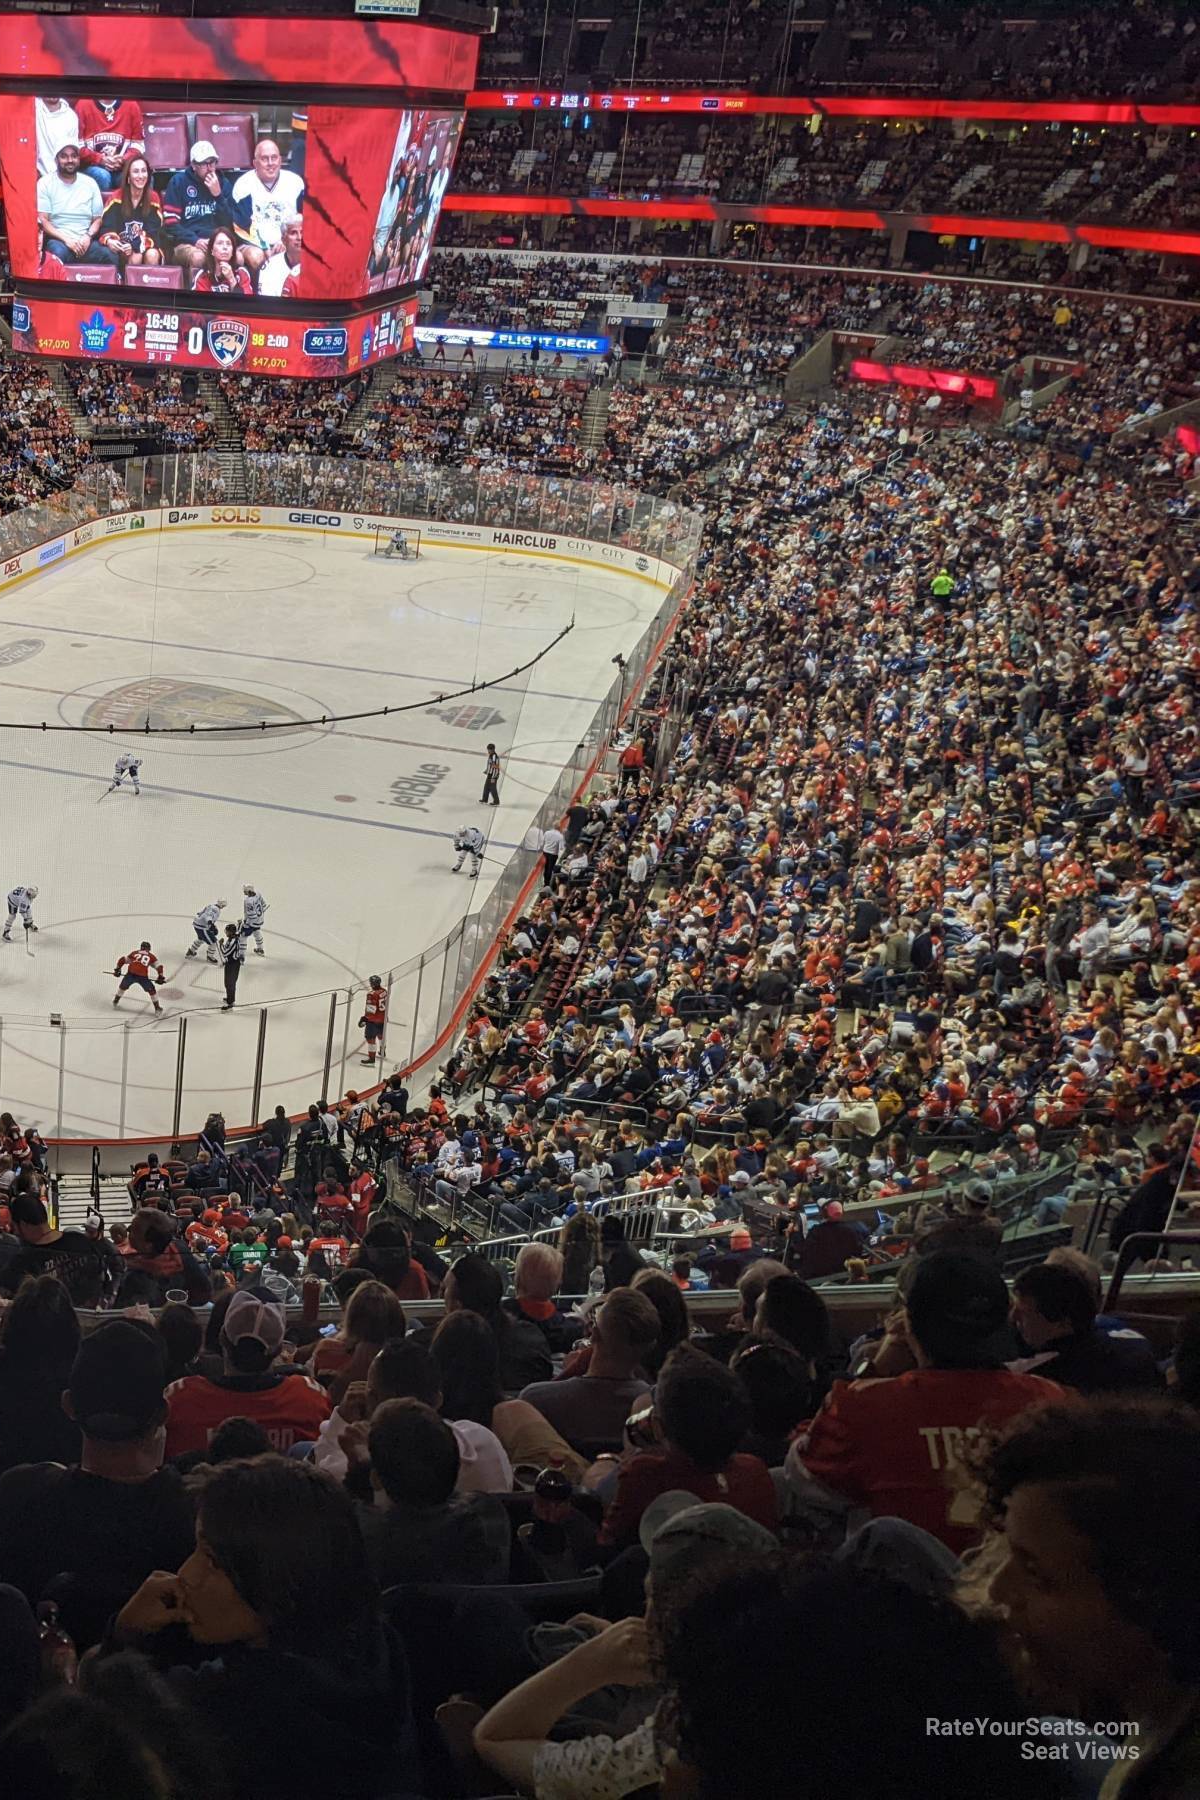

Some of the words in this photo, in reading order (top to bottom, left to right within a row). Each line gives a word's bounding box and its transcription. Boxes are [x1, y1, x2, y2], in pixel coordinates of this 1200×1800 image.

[550, 96, 556, 106] 2
[583, 97, 590, 107] 0
[145, 313, 180, 332] 16:49
[607, 317, 622, 325] 109
[212, 322, 244, 333] FLORIDA
[85, 329, 109, 340] TORONTO
[123, 322, 138, 350] 2
[252, 333, 265, 347] 98
[267, 334, 289, 348] 2:00
[38, 338, 70, 350] $47,070
[188, 327, 203, 355] 0
[310, 336, 323, 347] 50
[333, 336, 343, 347] 50
[556, 337, 598, 350] DECK
[252, 357, 287, 368] $47,070
[106, 516, 127, 527] TRULY
[211, 508, 261, 524] SOLIS
[288, 513, 341, 526] GEICO
[493, 532, 556, 550] HAIRCLUB
[567, 540, 594, 552] CITY
[602, 548, 626, 561] CITY
[4, 557, 21, 576] DEX
[377, 763, 453, 814] jetBlue
